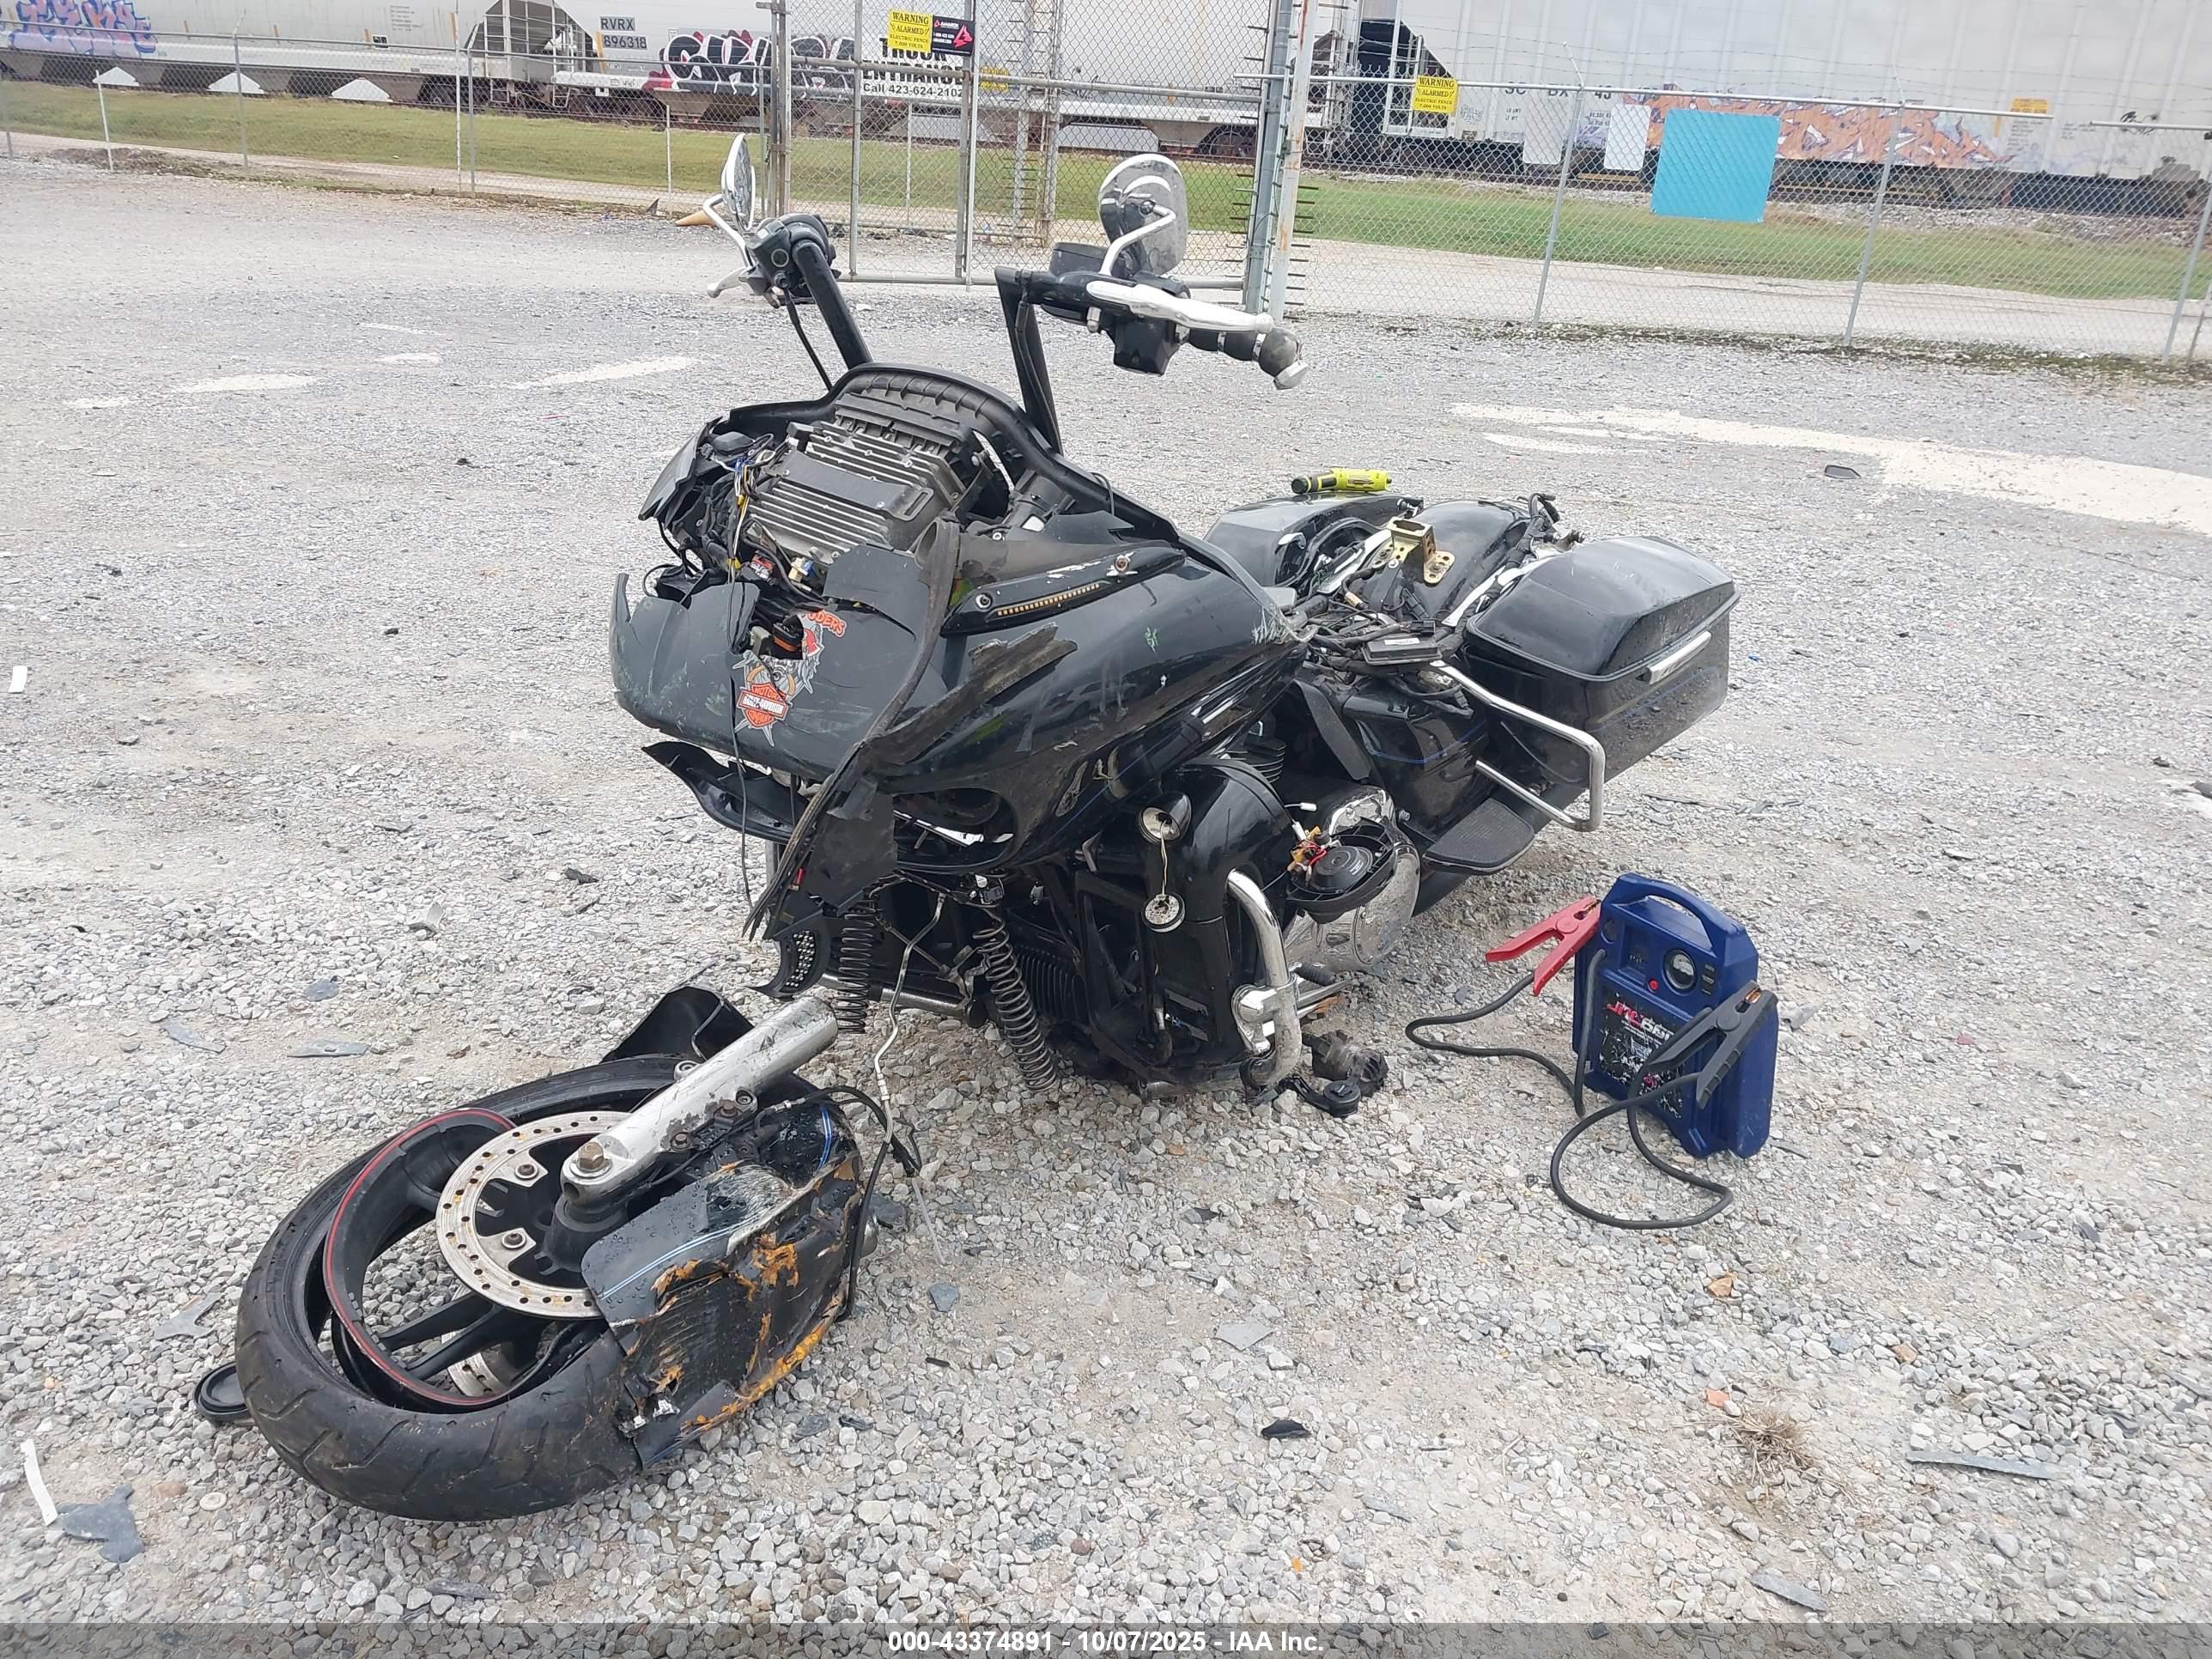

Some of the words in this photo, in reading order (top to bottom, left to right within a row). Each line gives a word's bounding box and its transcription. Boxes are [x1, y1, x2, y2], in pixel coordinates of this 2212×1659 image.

[601, 18, 635, 30] RVRX
[893, 12, 929, 24] WARNING
[896, 25, 924, 34] ALARMED
[604, 35, 647, 49] 896318
[1419, 77, 1455, 88] WARNING
[863, 83, 885, 94] Call
[889, 84, 963, 97] 423-624-2102
